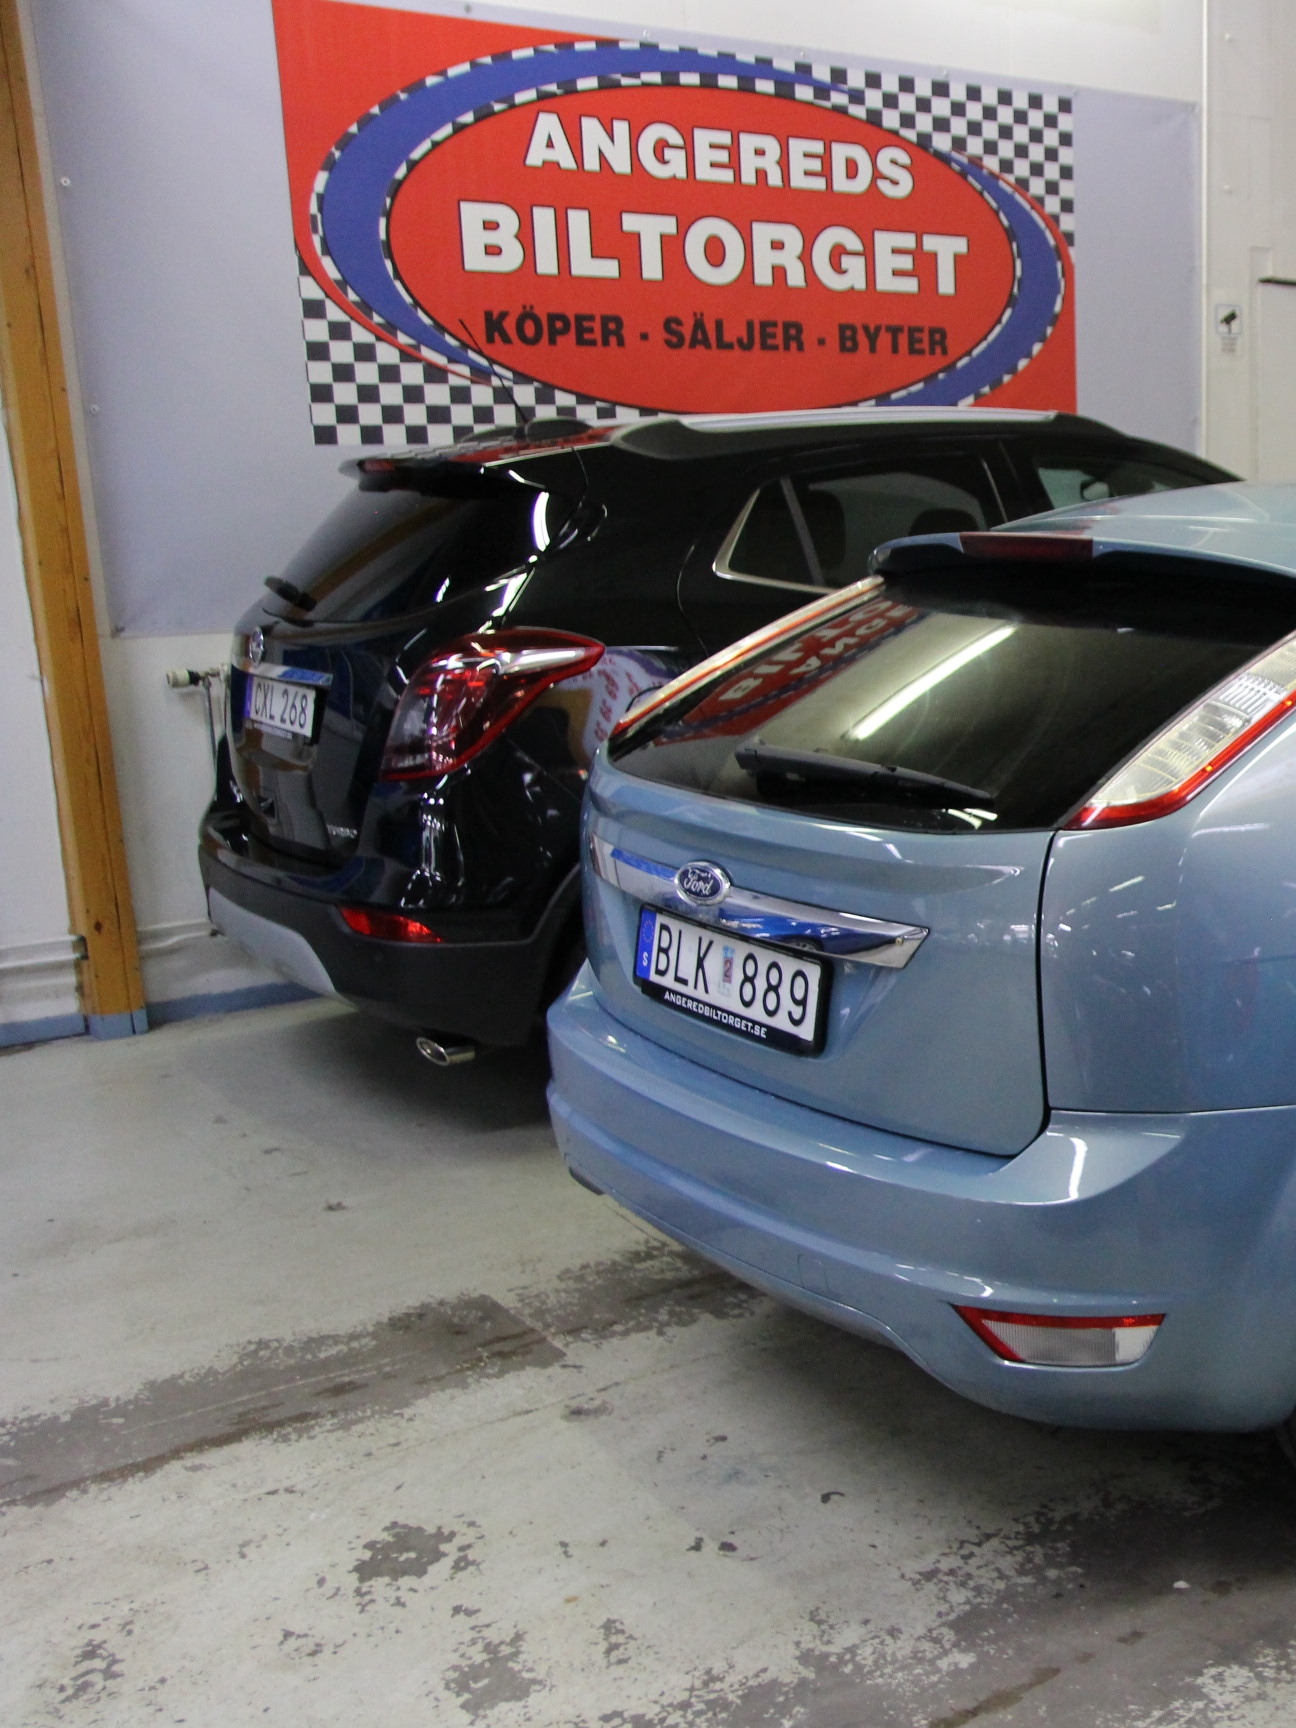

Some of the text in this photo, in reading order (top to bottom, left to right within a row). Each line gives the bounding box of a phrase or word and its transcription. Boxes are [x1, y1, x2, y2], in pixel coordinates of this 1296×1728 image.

[525, 111, 914, 199] ANGEREDS
[458, 200, 968, 295] BILTORGET
[483, 305, 625, 348] KÖPER
[663, 312, 805, 352] SÄLJER
[838, 323, 949, 356] BYTER
[255, 682, 308, 729] CXL 268
[683, 866, 714, 896] Ford
[642, 951, 649, 967] S
[654, 922, 809, 1027] BLK 889
[663, 990, 768, 1039] ANGEREDBILTORGET.SE
